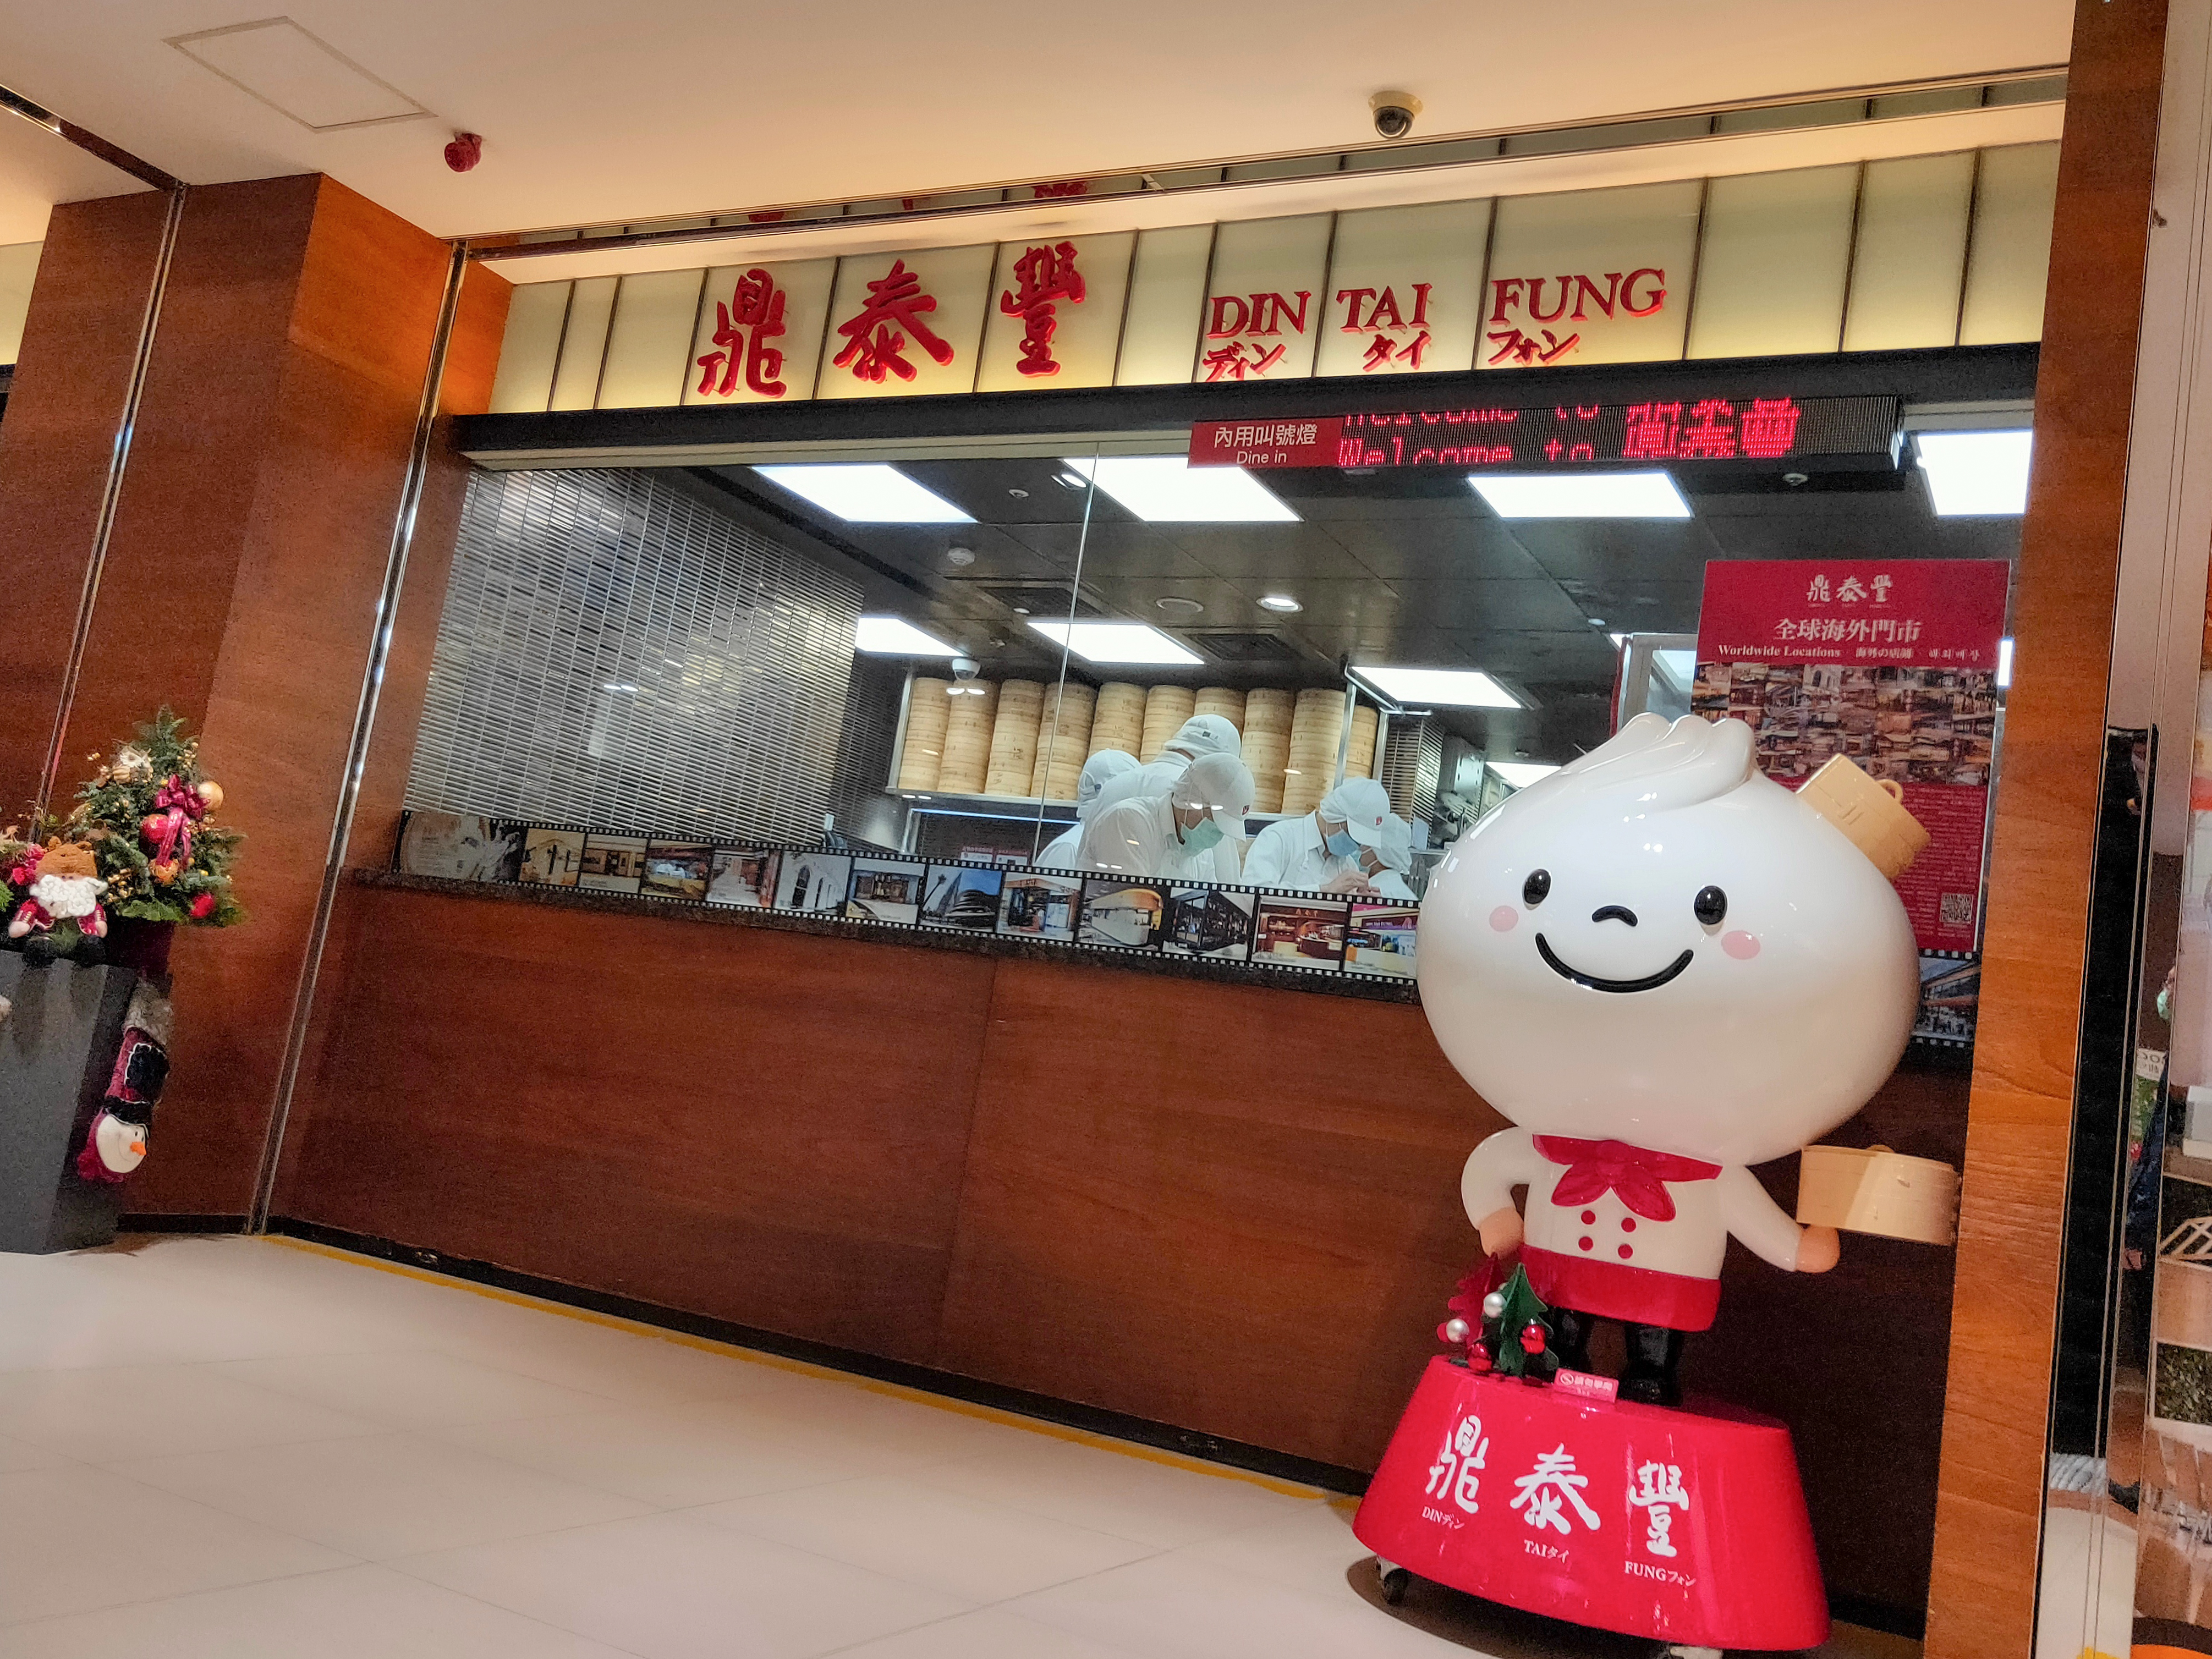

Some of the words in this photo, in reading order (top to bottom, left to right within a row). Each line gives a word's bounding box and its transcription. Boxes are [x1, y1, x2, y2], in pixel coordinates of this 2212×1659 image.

[697, 241, 1087, 399] 鼎泰豐
[1206, 290, 1312, 339] DIN
[1336, 283, 1432, 333] TAI
[1489, 268, 1667, 327] FUNG
[1202, 341, 1287, 381] ディン
[1363, 330, 1431, 372] タイ
[1486, 328, 1580, 365] フォン
[1237, 450, 1269, 464] Dine
[1274, 449, 1287, 463] in
[1807, 574, 1893, 603] 鼎泰豐
[1773, 618, 1922, 643] 全球海外門市
[1718, 645, 1781, 657] Worldwide
[1783, 645, 1841, 658] Locations
[1425, 1415, 1689, 1558] 鼎泰豐
